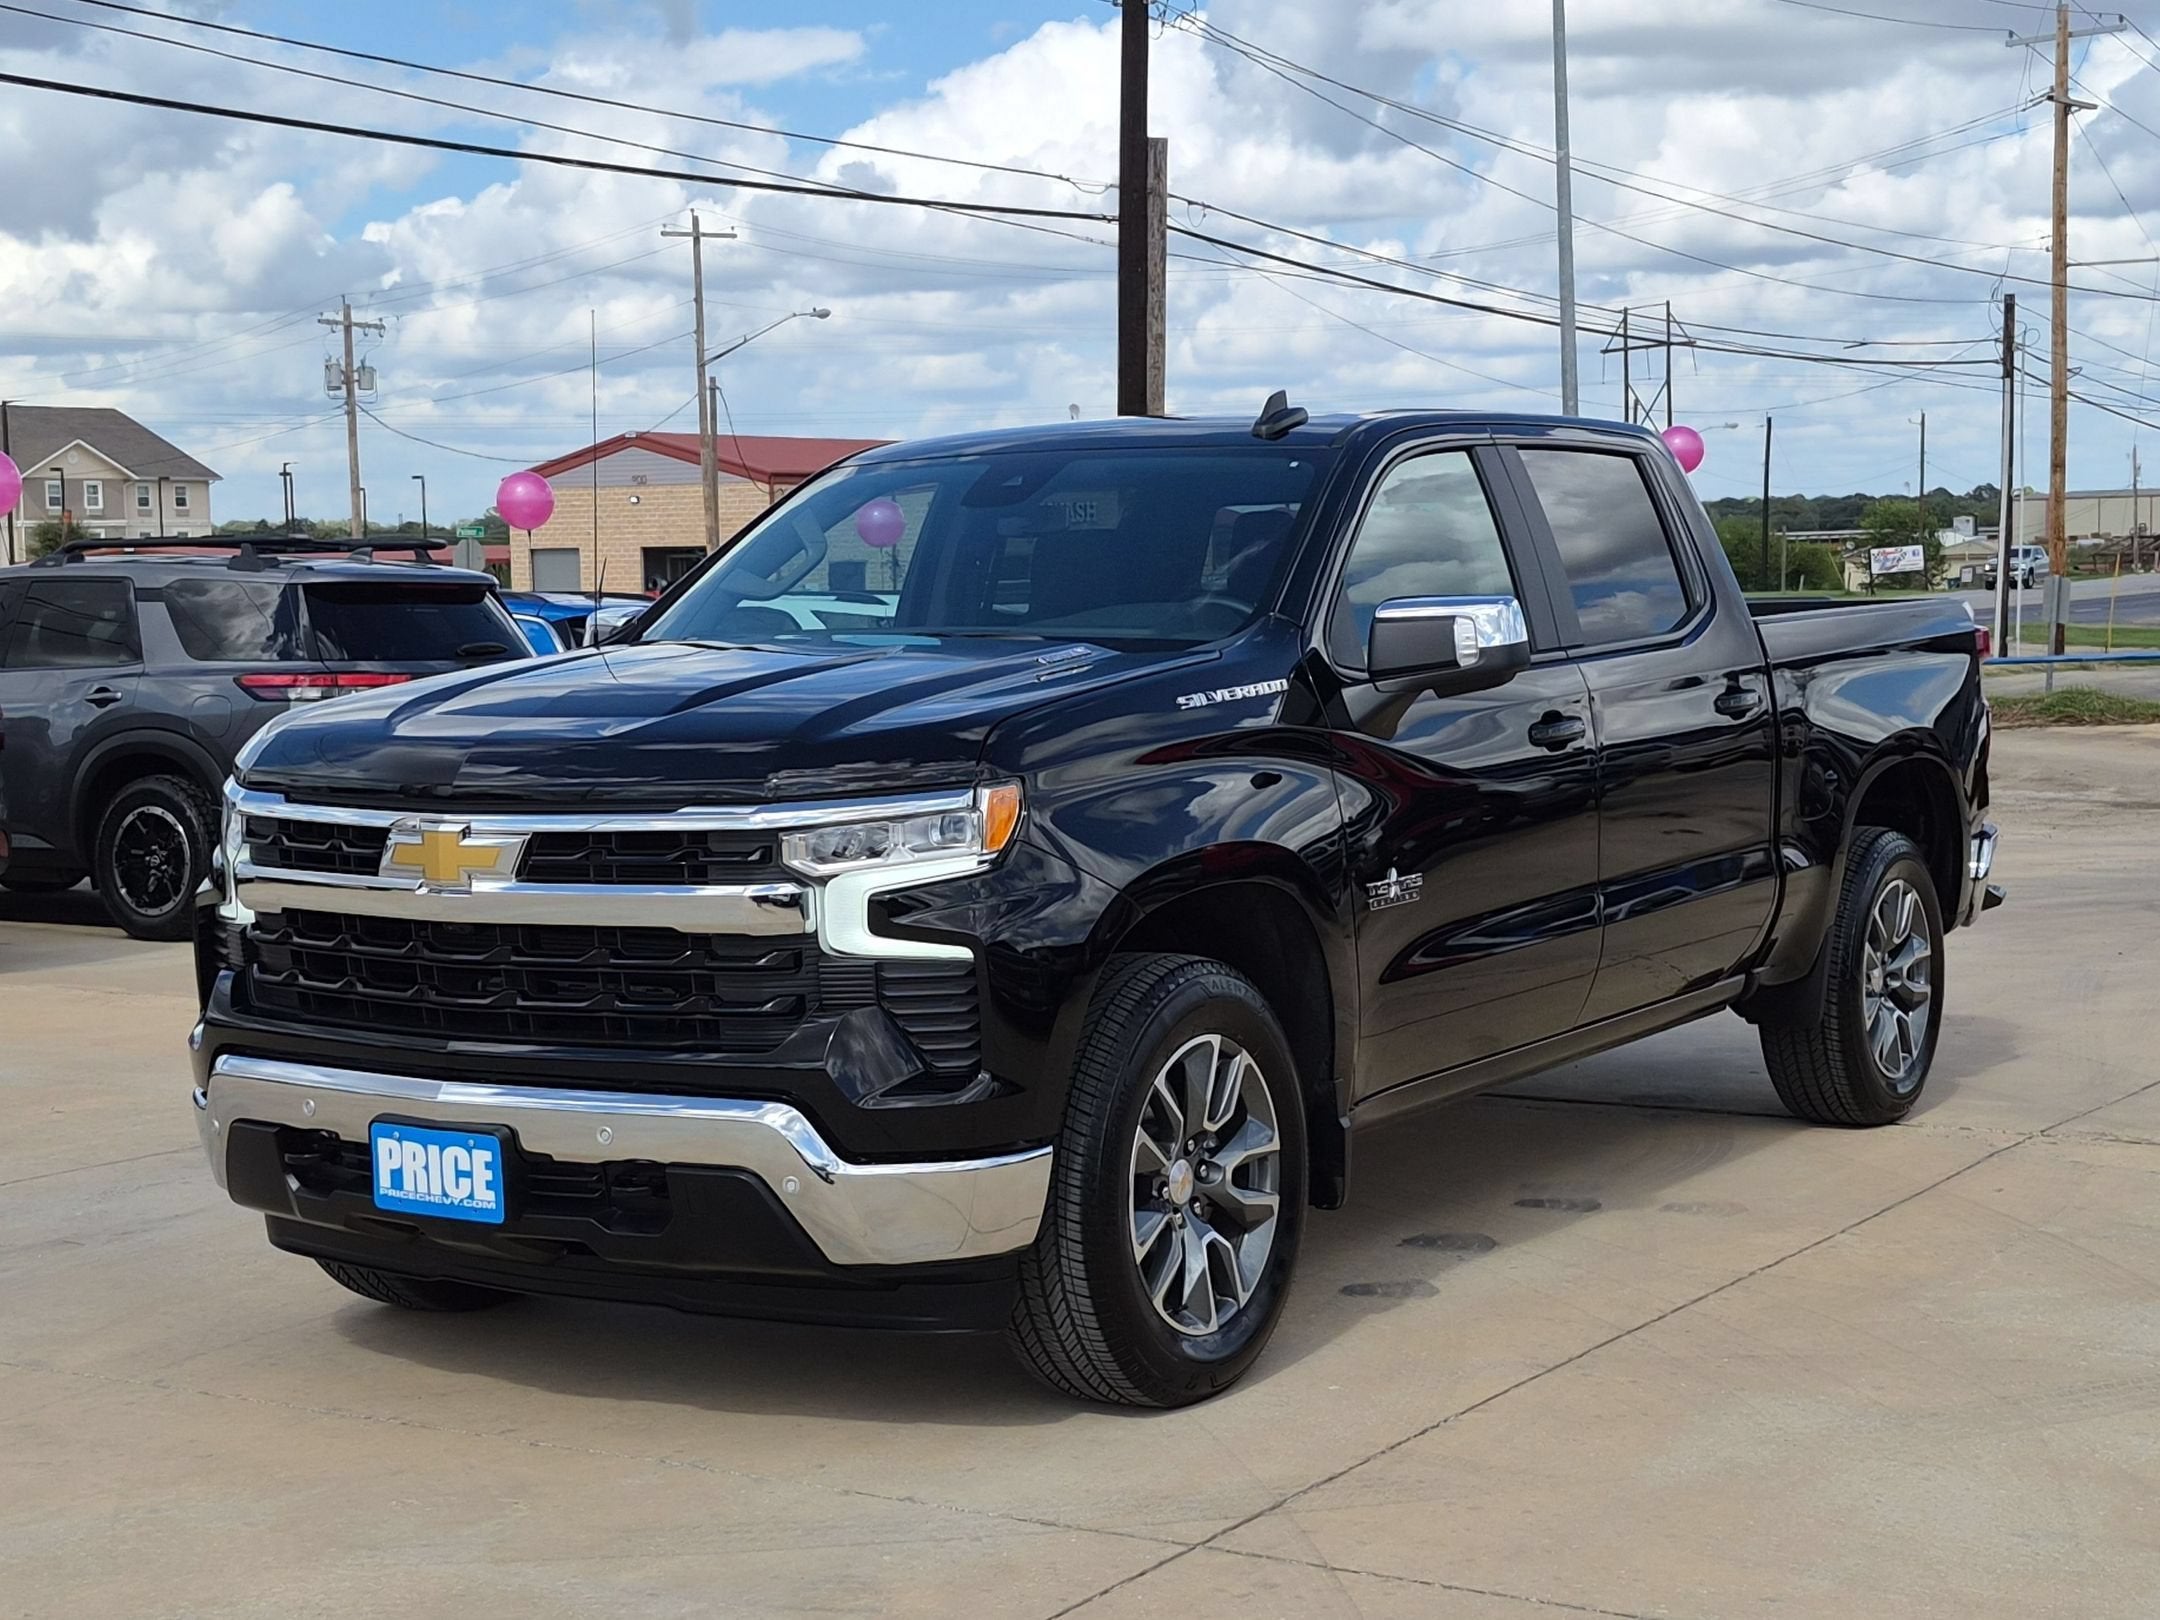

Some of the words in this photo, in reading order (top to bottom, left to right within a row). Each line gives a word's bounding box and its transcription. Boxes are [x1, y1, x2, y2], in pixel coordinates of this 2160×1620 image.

[1176, 679, 1289, 710] SILVERADO
[377, 1137, 496, 1201] PRICE
[379, 1187, 497, 1210] PRICECHEVY.COM
